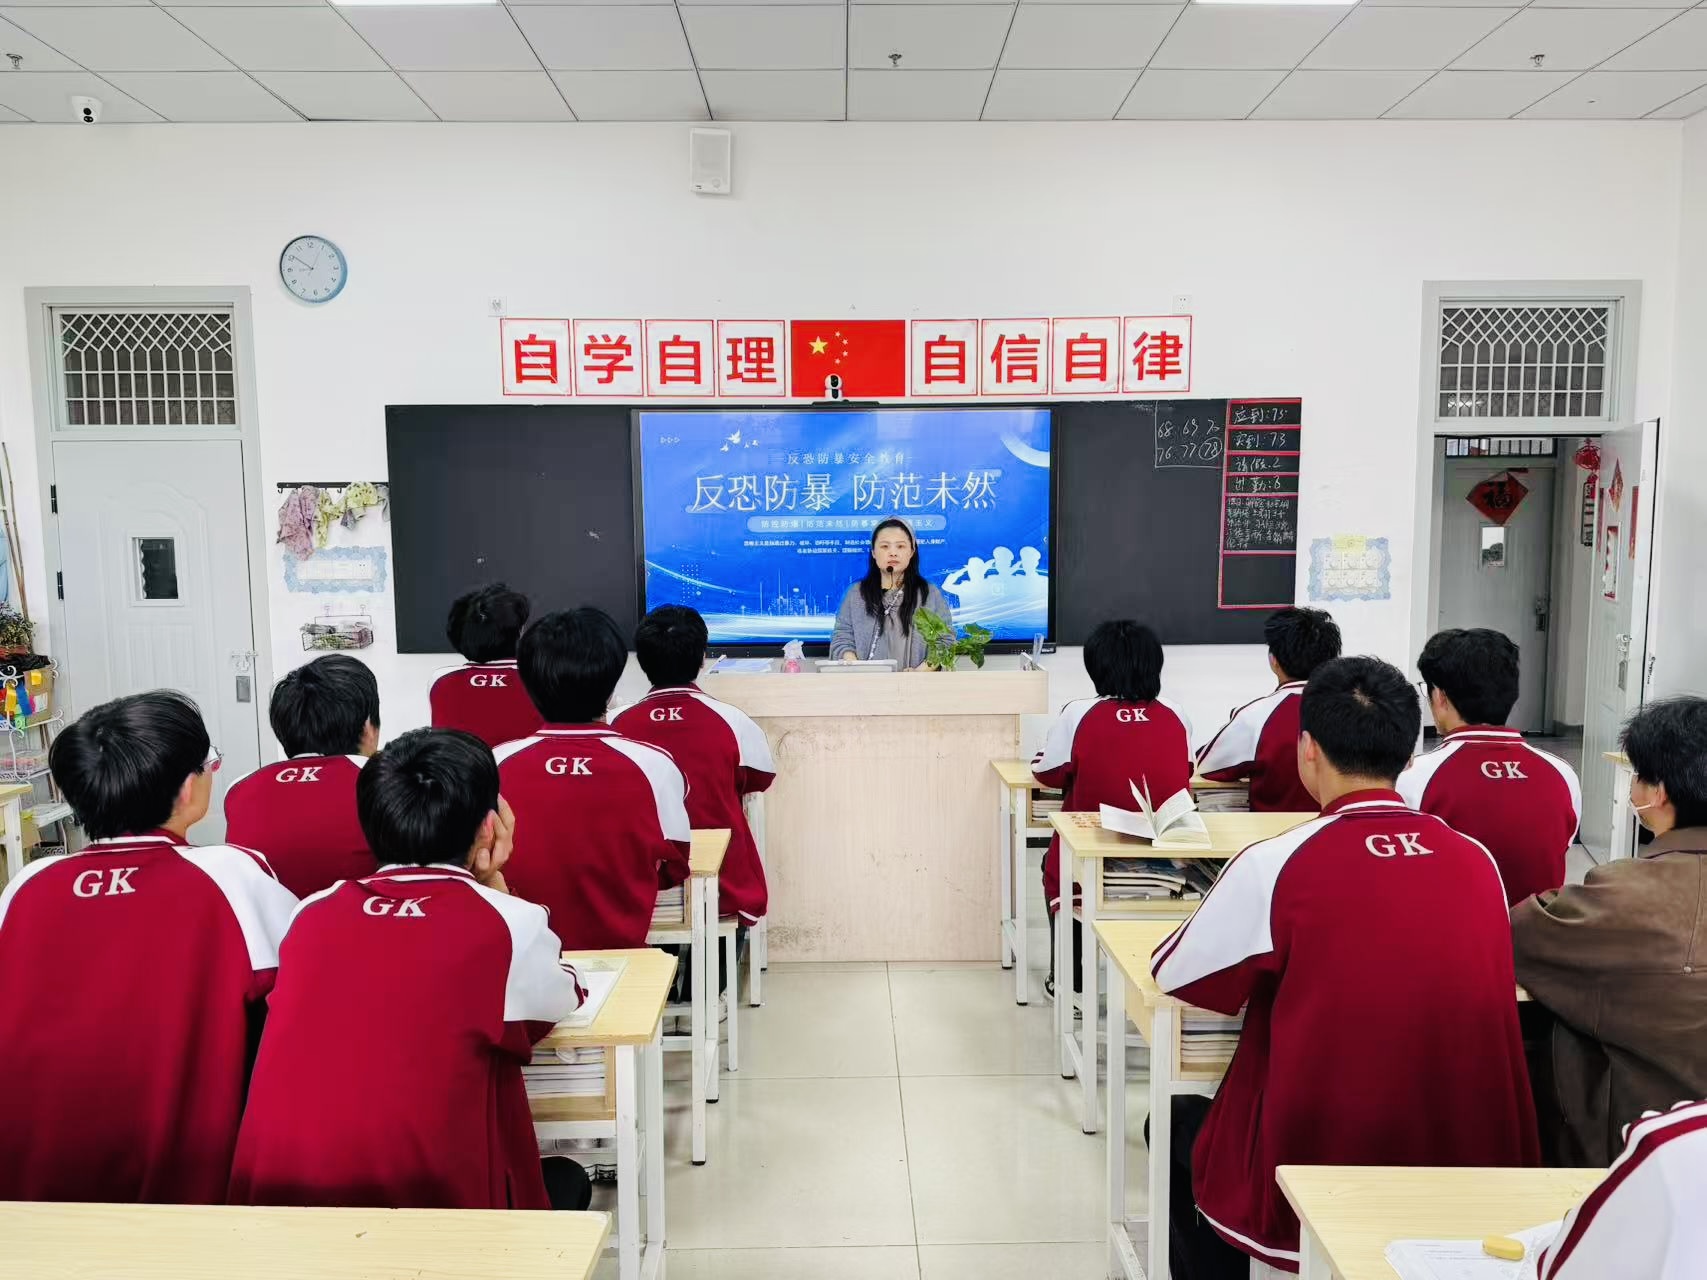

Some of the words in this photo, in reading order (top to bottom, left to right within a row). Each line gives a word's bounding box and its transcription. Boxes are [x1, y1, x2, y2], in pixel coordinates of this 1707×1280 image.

[514, 332, 777, 385] 自学自理
[924, 331, 1184, 385] 自信自律
[1203, 441, 1218, 457] 78
[691, 473, 833, 511] 反恐防暴
[853, 472, 998, 511] 防范未然
[469, 674, 507, 687] GK
[649, 706, 684, 722] GK
[1115, 707, 1150, 723] GK
[275, 766, 323, 783] GK
[545, 756, 593, 775] GK
[1480, 760, 1528, 779] GK
[1365, 832, 1434, 858] GK
[72, 867, 139, 898] GK
[362, 895, 430, 917] GK
